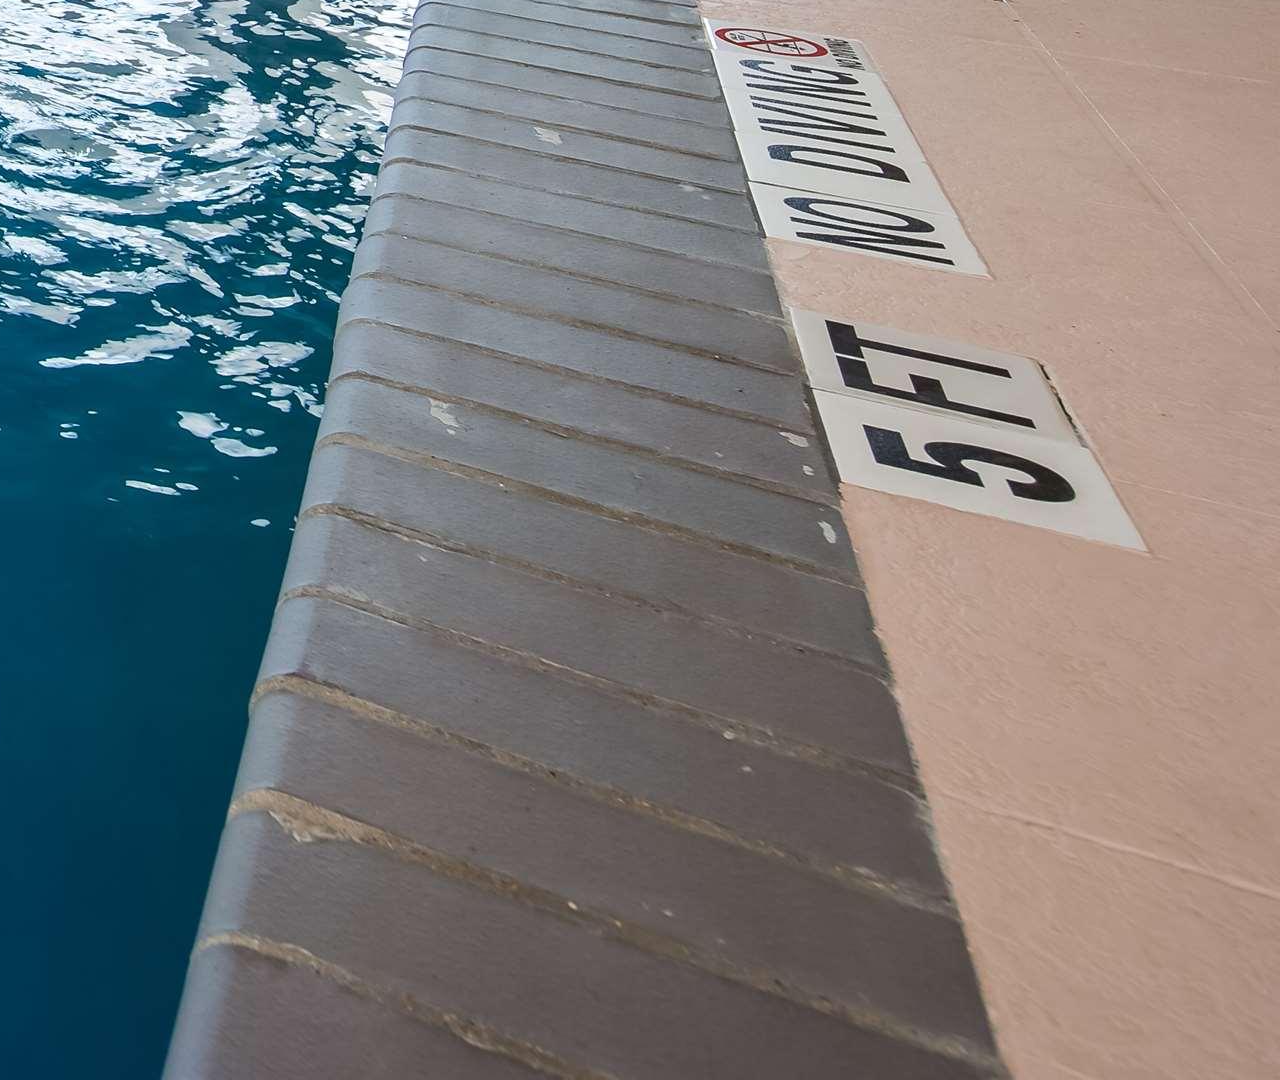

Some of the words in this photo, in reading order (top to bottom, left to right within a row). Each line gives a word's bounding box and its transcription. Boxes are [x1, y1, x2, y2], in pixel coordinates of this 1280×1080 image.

[738, 59, 911, 183] DIVING
[783, 196, 956, 266] NO
[824, 319, 1038, 430] FT
[862, 423, 1077, 504] 5
